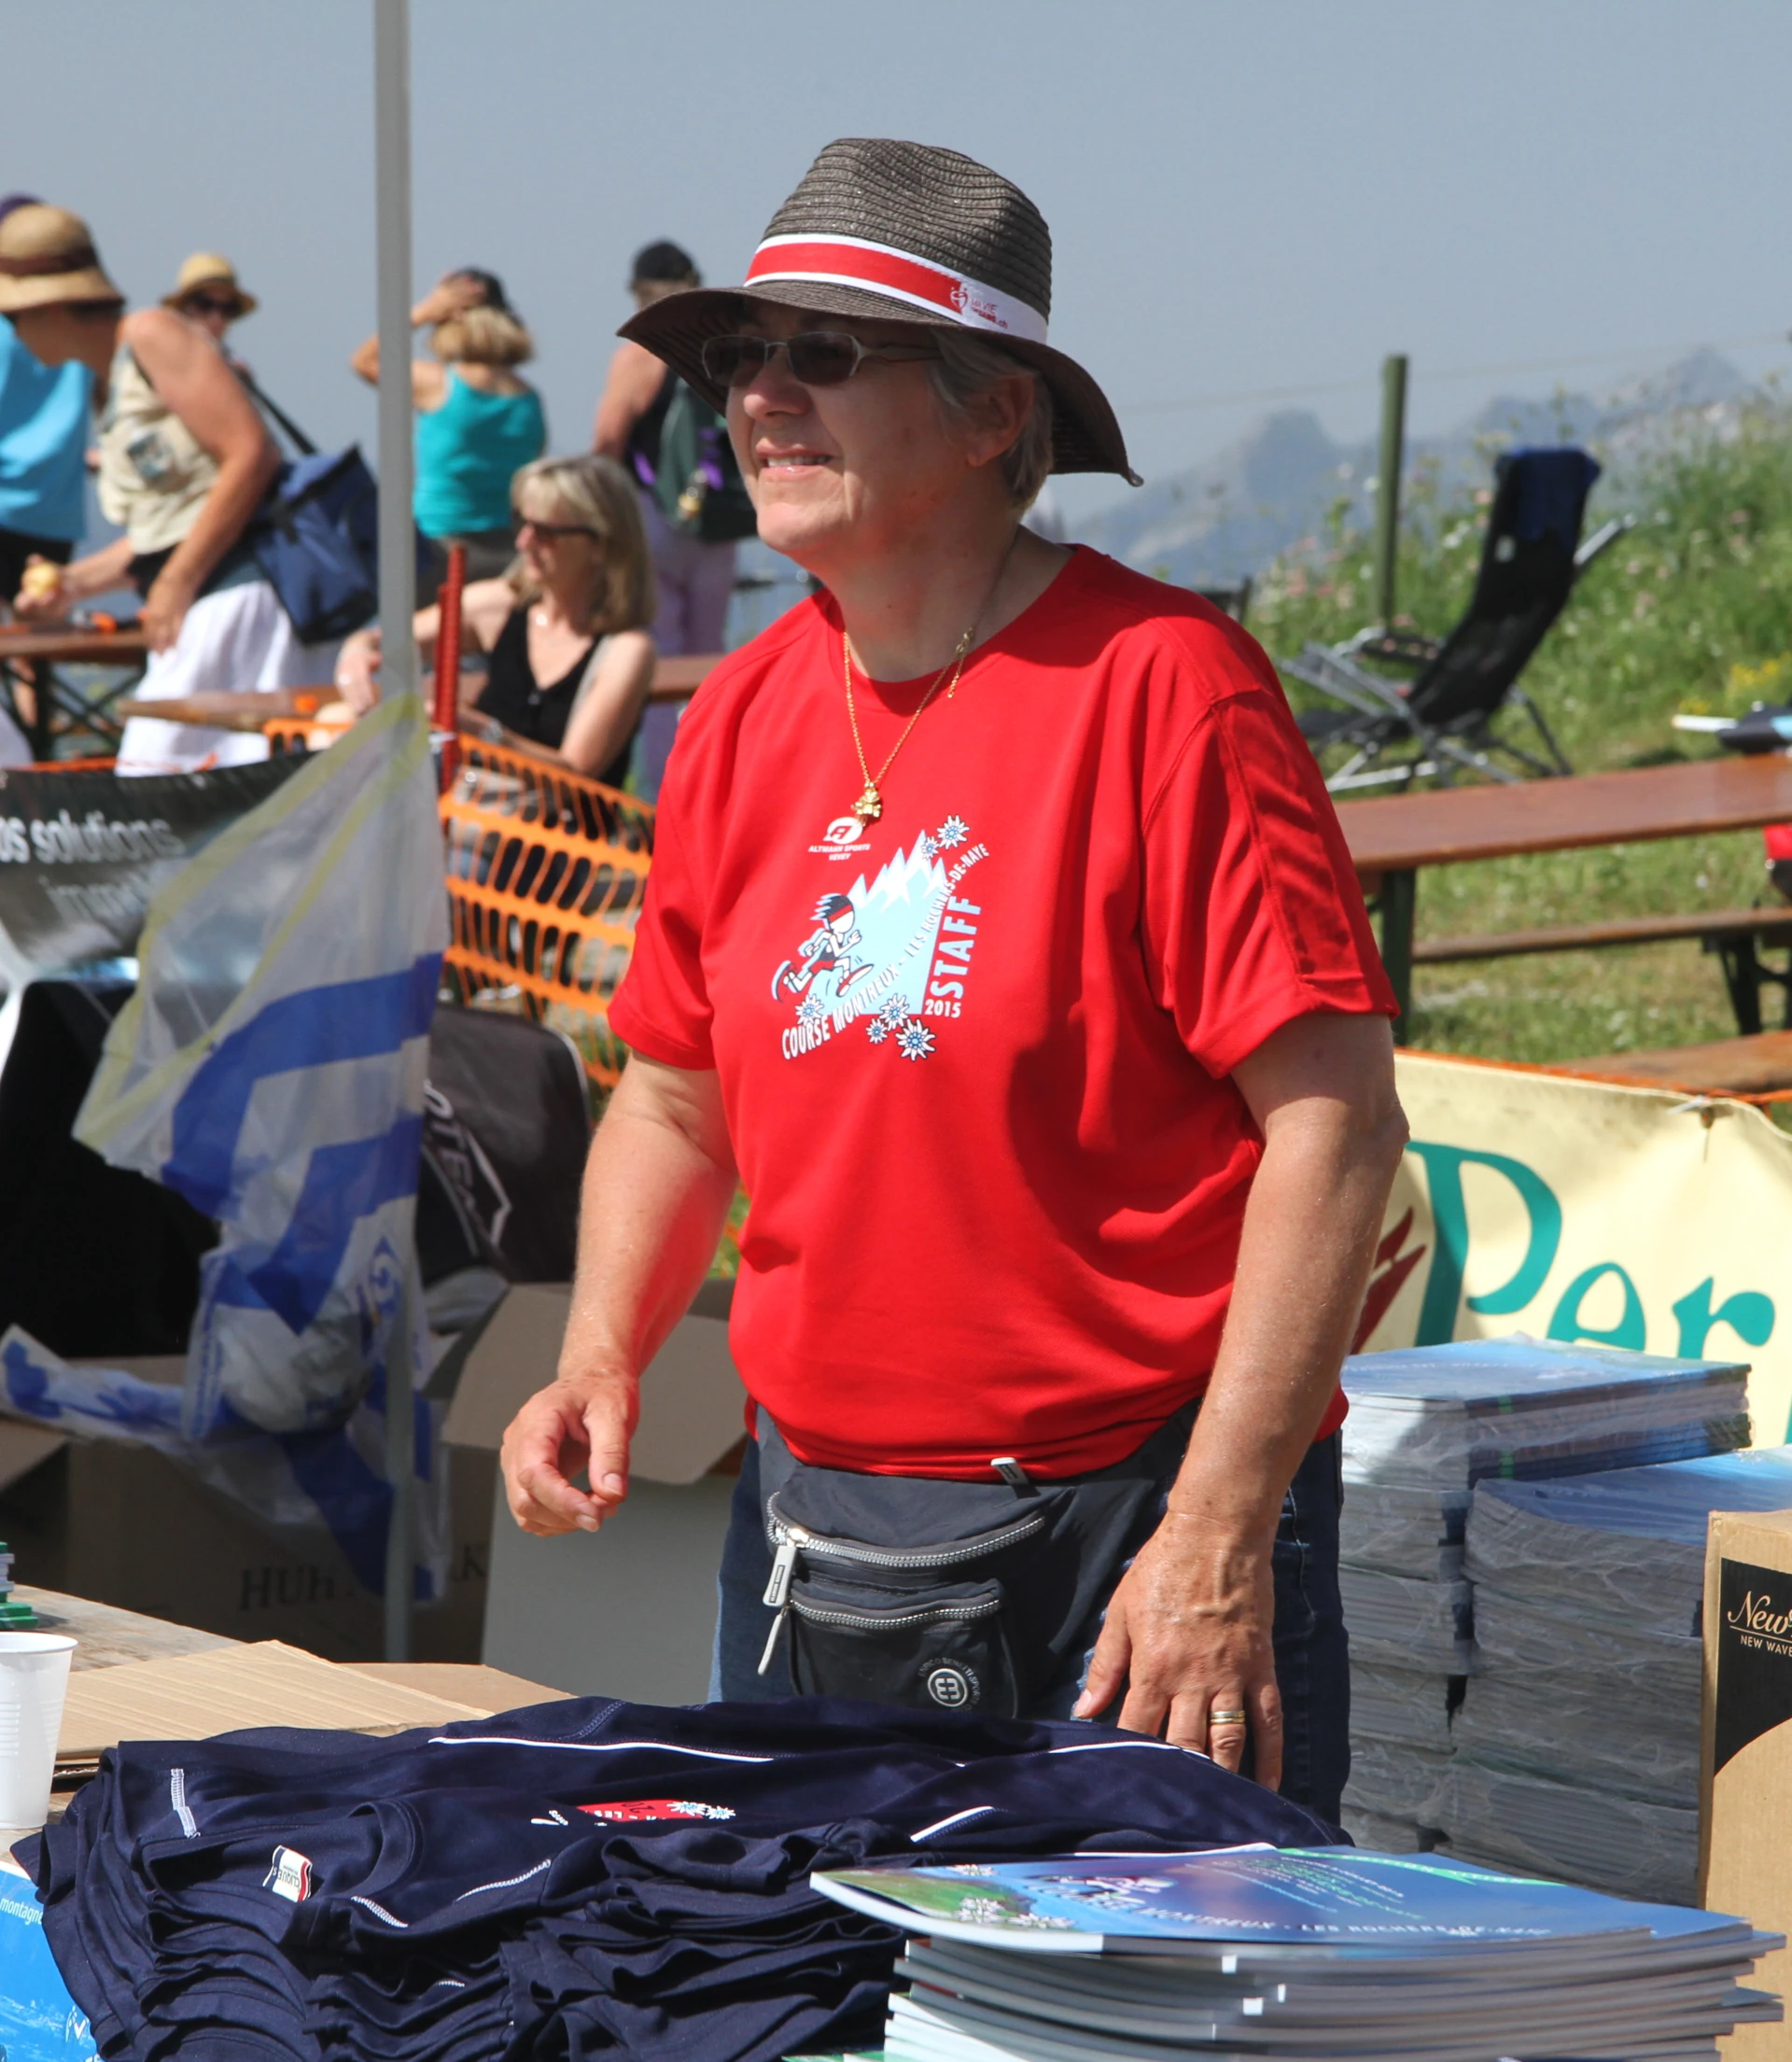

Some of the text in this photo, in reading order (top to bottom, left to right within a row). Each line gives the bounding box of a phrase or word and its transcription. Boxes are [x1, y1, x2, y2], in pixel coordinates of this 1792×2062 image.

[31, 808, 185, 863] solutions
[844, 843, 871, 852] SPORTS
[930, 895, 982, 1000] STAFF
[782, 1014, 831, 1060] COURSE
[832, 964, 900, 1033] MONTREUX
[903, 933, 929, 958] LES
[924, 999, 961, 1018] 2015
[1405, 1141, 1776, 1360] Per
[1740, 1634, 1792, 1658] NEW WAVE
[277, 1869, 301, 1888] CLIQUE
[0, 1897, 43, 1926] montagne
